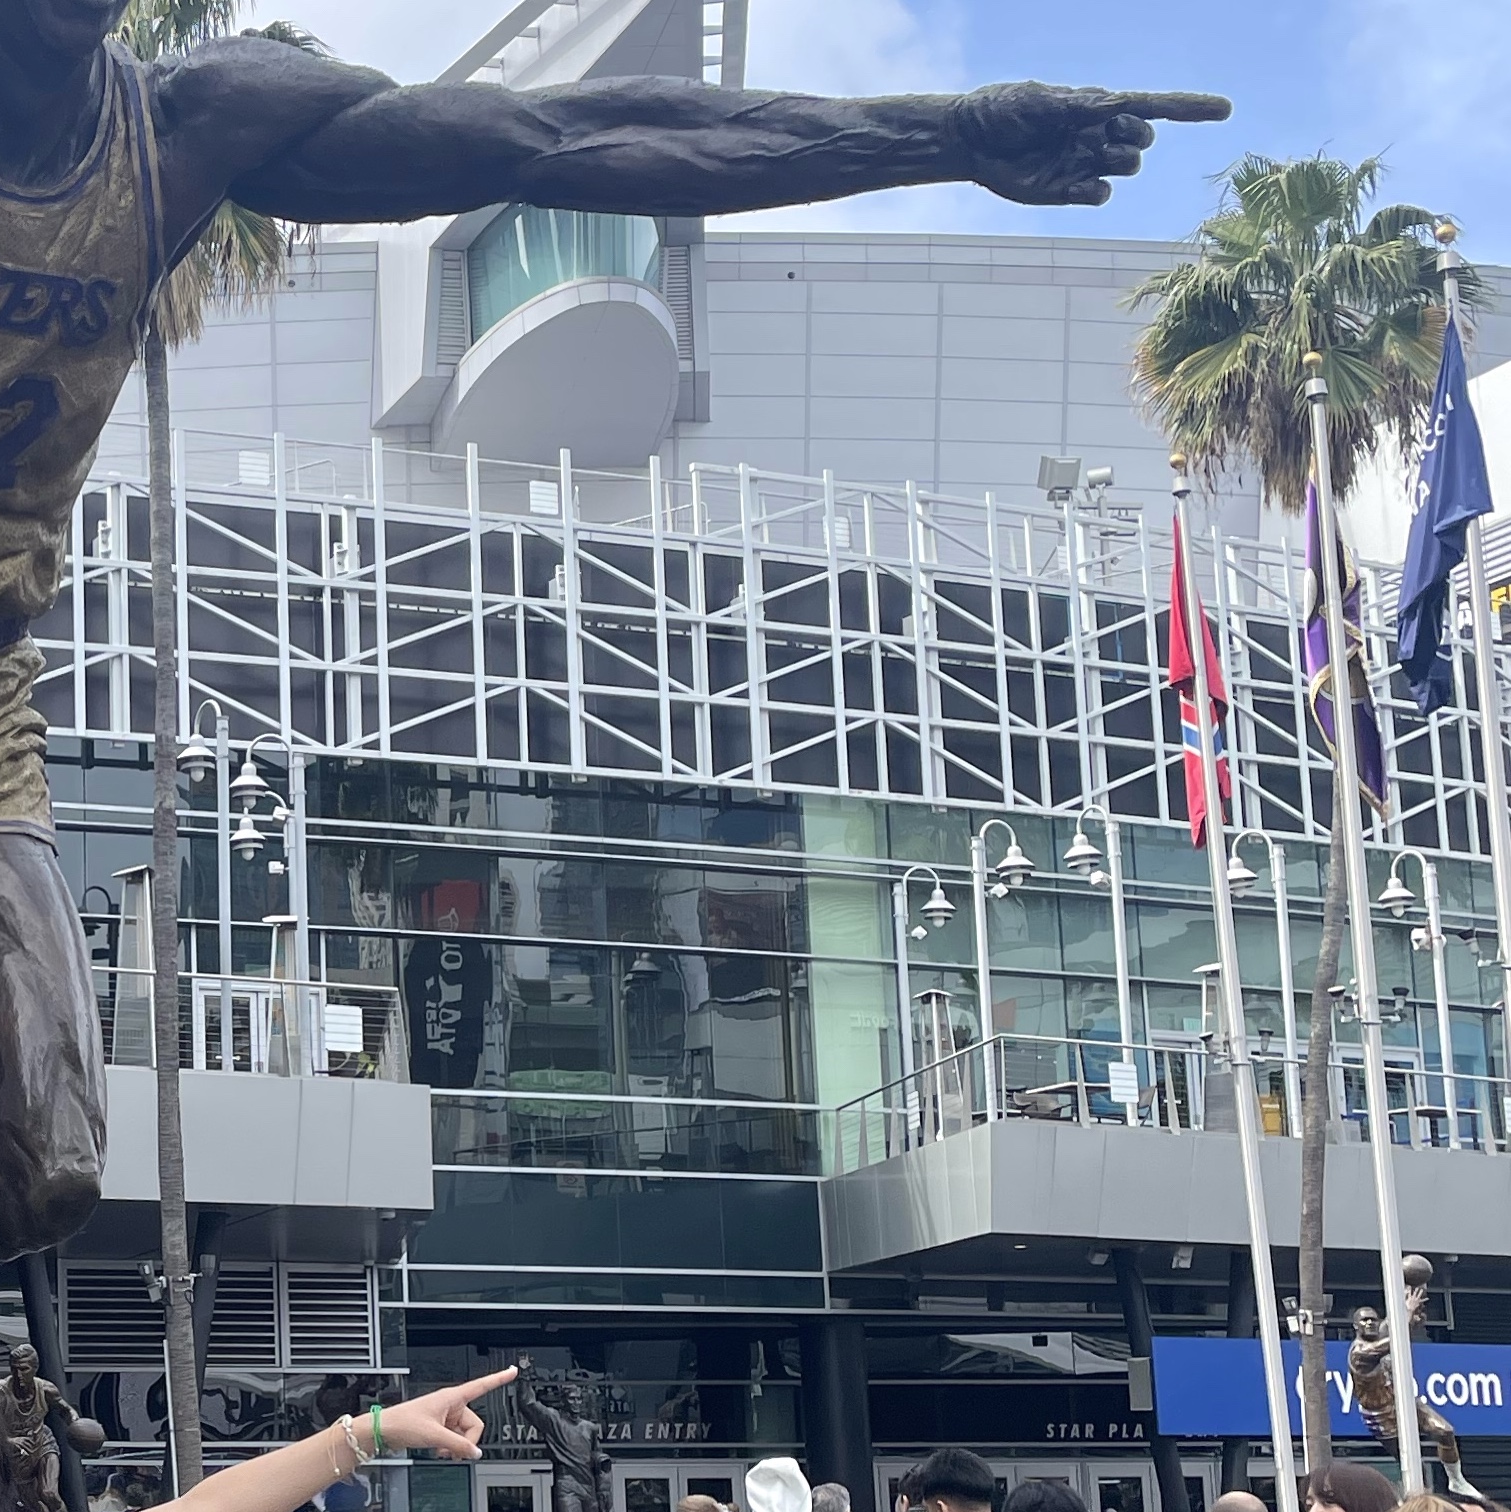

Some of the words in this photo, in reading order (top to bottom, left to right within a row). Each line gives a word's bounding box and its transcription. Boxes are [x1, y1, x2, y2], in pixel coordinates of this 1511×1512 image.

[1295, 1371, 1504, 1414] y.com
[502, 1424, 539, 1440] STA
[595, 1422, 632, 1440] AZA
[644, 1422, 713, 1440] ENTRY
[1046, 1423, 1095, 1439] STAR
[1108, 1423, 1144, 1439] PLA
